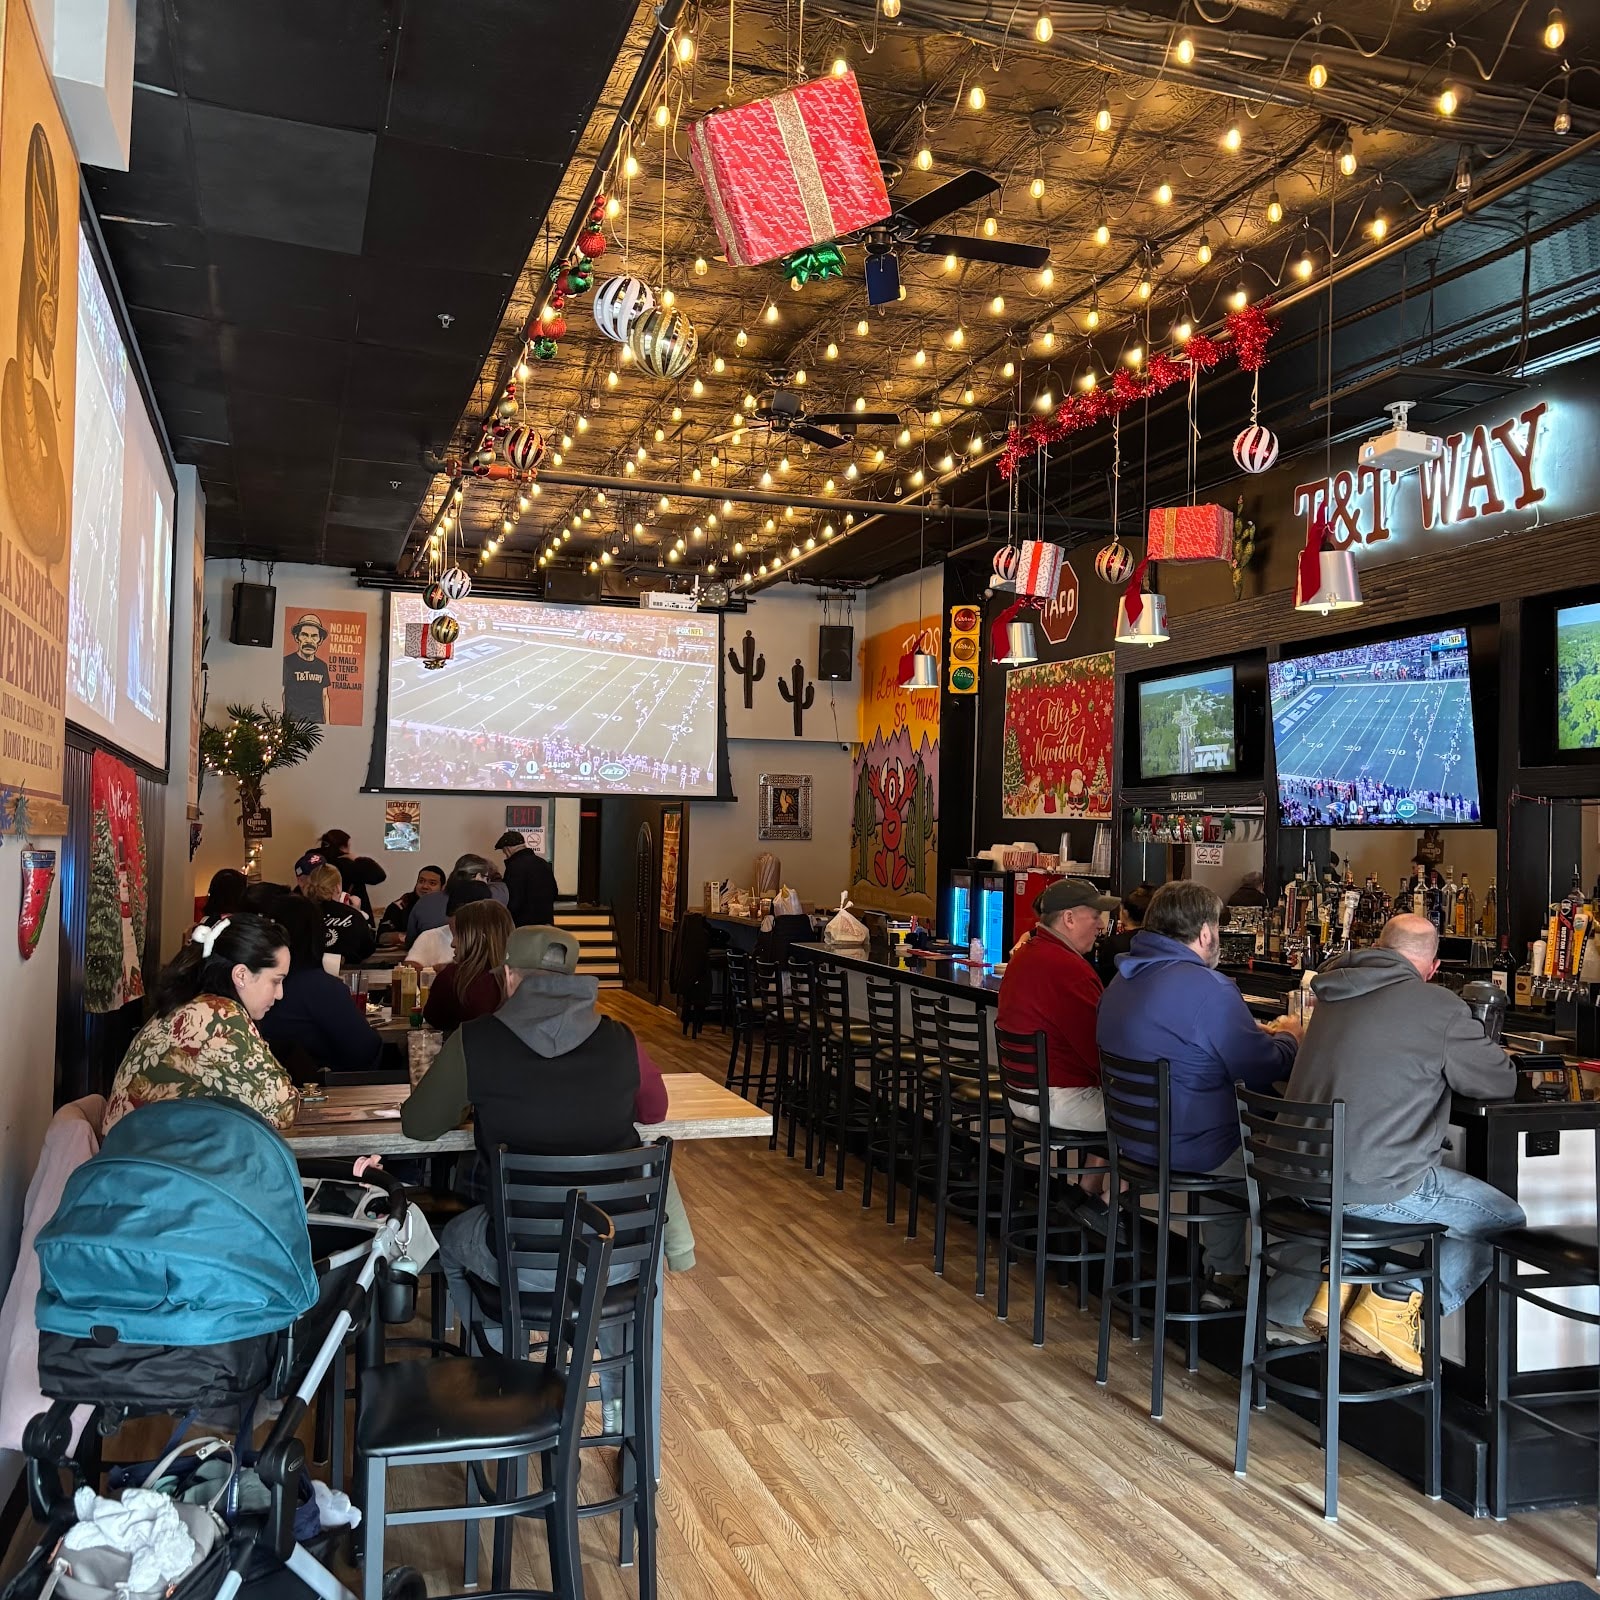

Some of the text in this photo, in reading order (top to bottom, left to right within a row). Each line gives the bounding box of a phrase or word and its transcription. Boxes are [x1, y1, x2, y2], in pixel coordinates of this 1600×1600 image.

[1419, 402, 1548, 530] WAY
[15, 548, 64, 645] SERPIENTE
[330, 623, 361, 634] NO HAY
[330, 634, 362, 643] TRABAJO
[577, 629, 626, 643] JETS
[329, 643, 361, 655] MALO...
[0, 604, 61, 711] VENENOSA
[329, 656, 357, 665] LO MALO
[338, 665, 358, 673] TENER
[336, 673, 348, 682] QUE
[331, 681, 362, 691] TRABAJAR
[1280, 692, 1323, 735] JETS
[22, 735, 30, 763] DE
[1030, 723, 1087, 768] Navidad
[526, 760, 538, 774] 0
[580, 762, 592, 775] 0
[513, 808, 536, 825] EXIT
[324, 914, 353, 928] ink
[1558, 951, 1566, 970] LAGER
